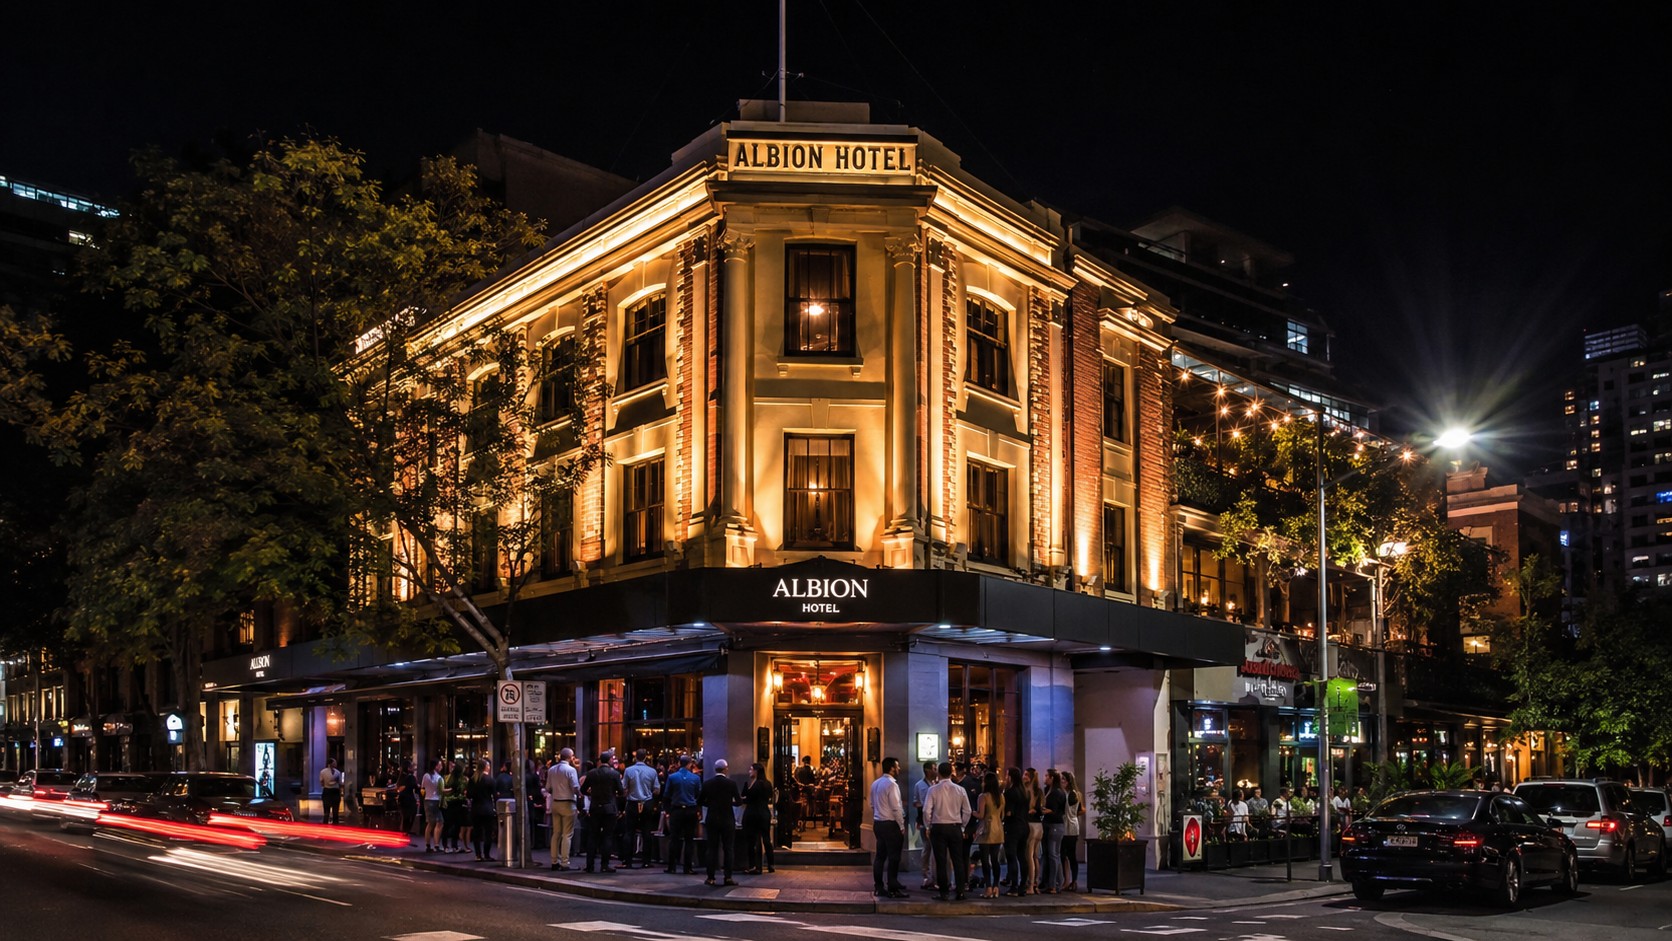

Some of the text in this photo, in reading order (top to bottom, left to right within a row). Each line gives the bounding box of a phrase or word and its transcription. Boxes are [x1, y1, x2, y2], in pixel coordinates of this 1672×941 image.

[734, 142, 911, 171] ALBION HOTEL
[772, 578, 869, 598] ALBION
[802, 603, 840, 613] HOTEL
